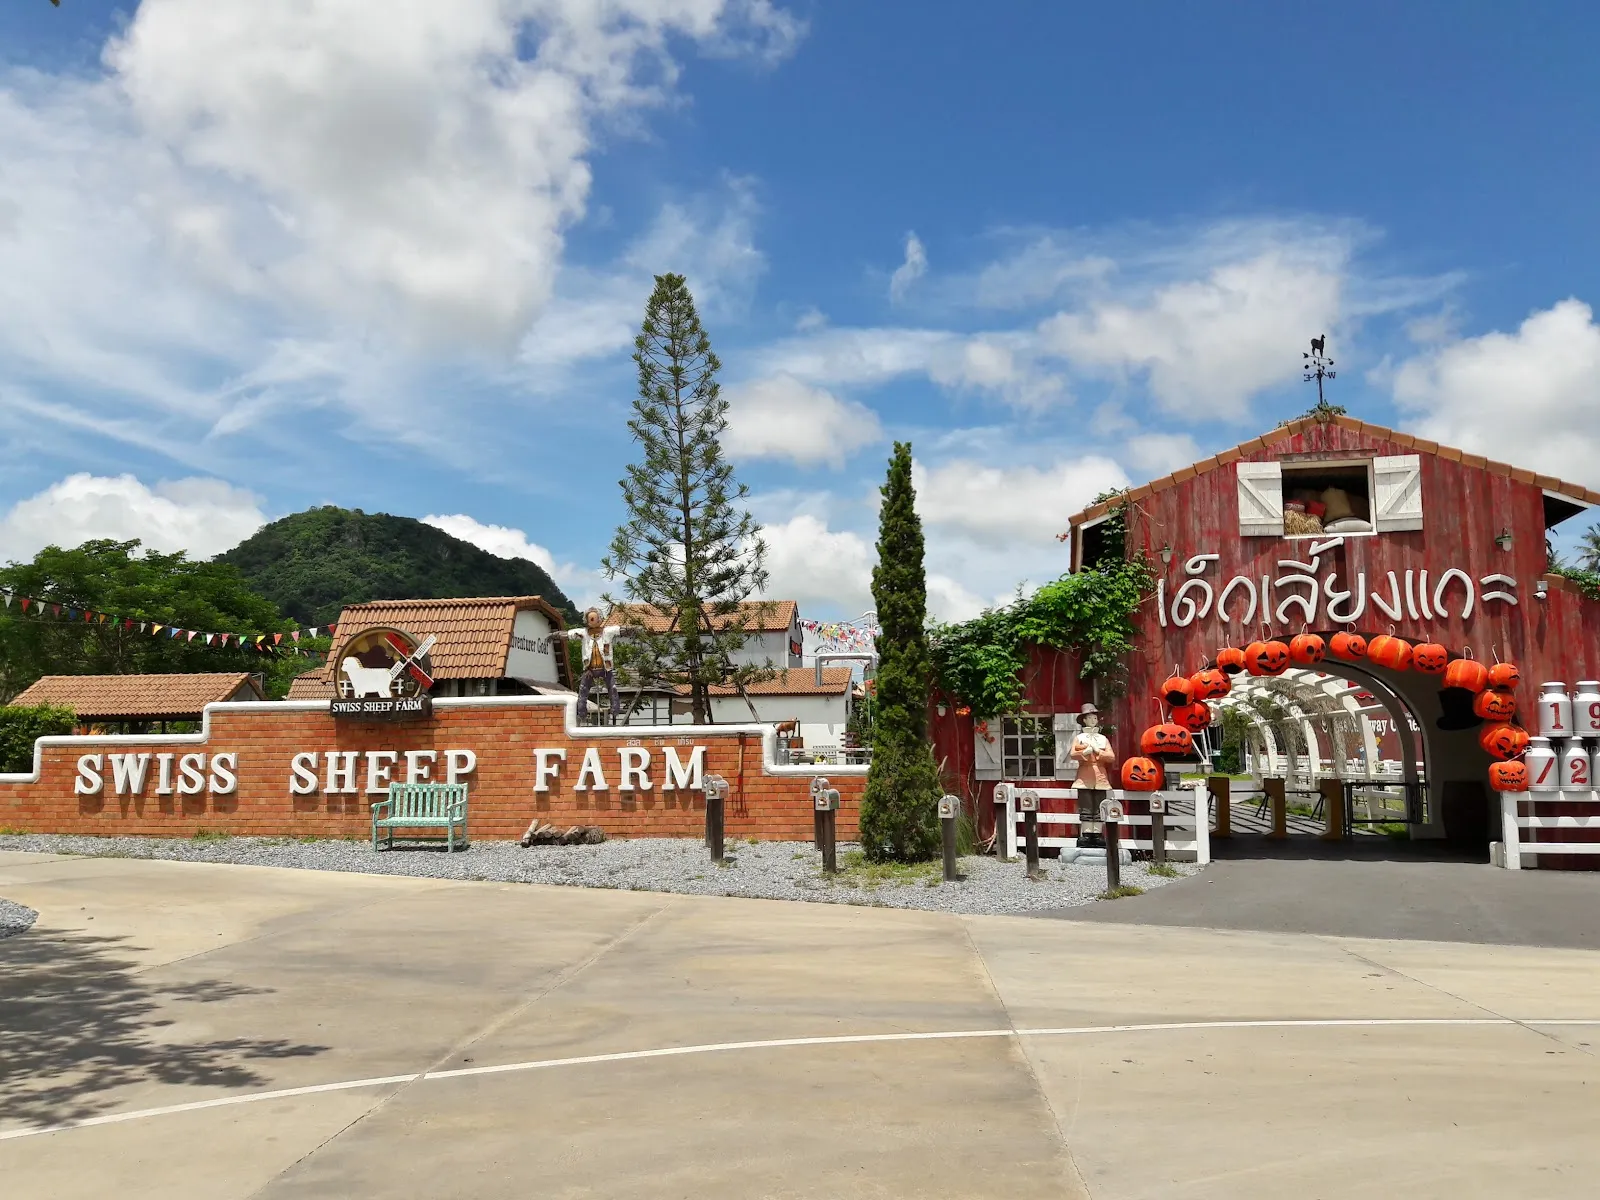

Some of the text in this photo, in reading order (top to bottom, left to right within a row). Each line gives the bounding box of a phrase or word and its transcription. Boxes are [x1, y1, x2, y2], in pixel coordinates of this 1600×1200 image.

[1157, 537, 1519, 627] เด็กเลี้ยงแกะ
[332, 700, 422, 713] SWISS SHEEP FARM
[74, 746, 708, 795] SWISS SHEEP FARM
